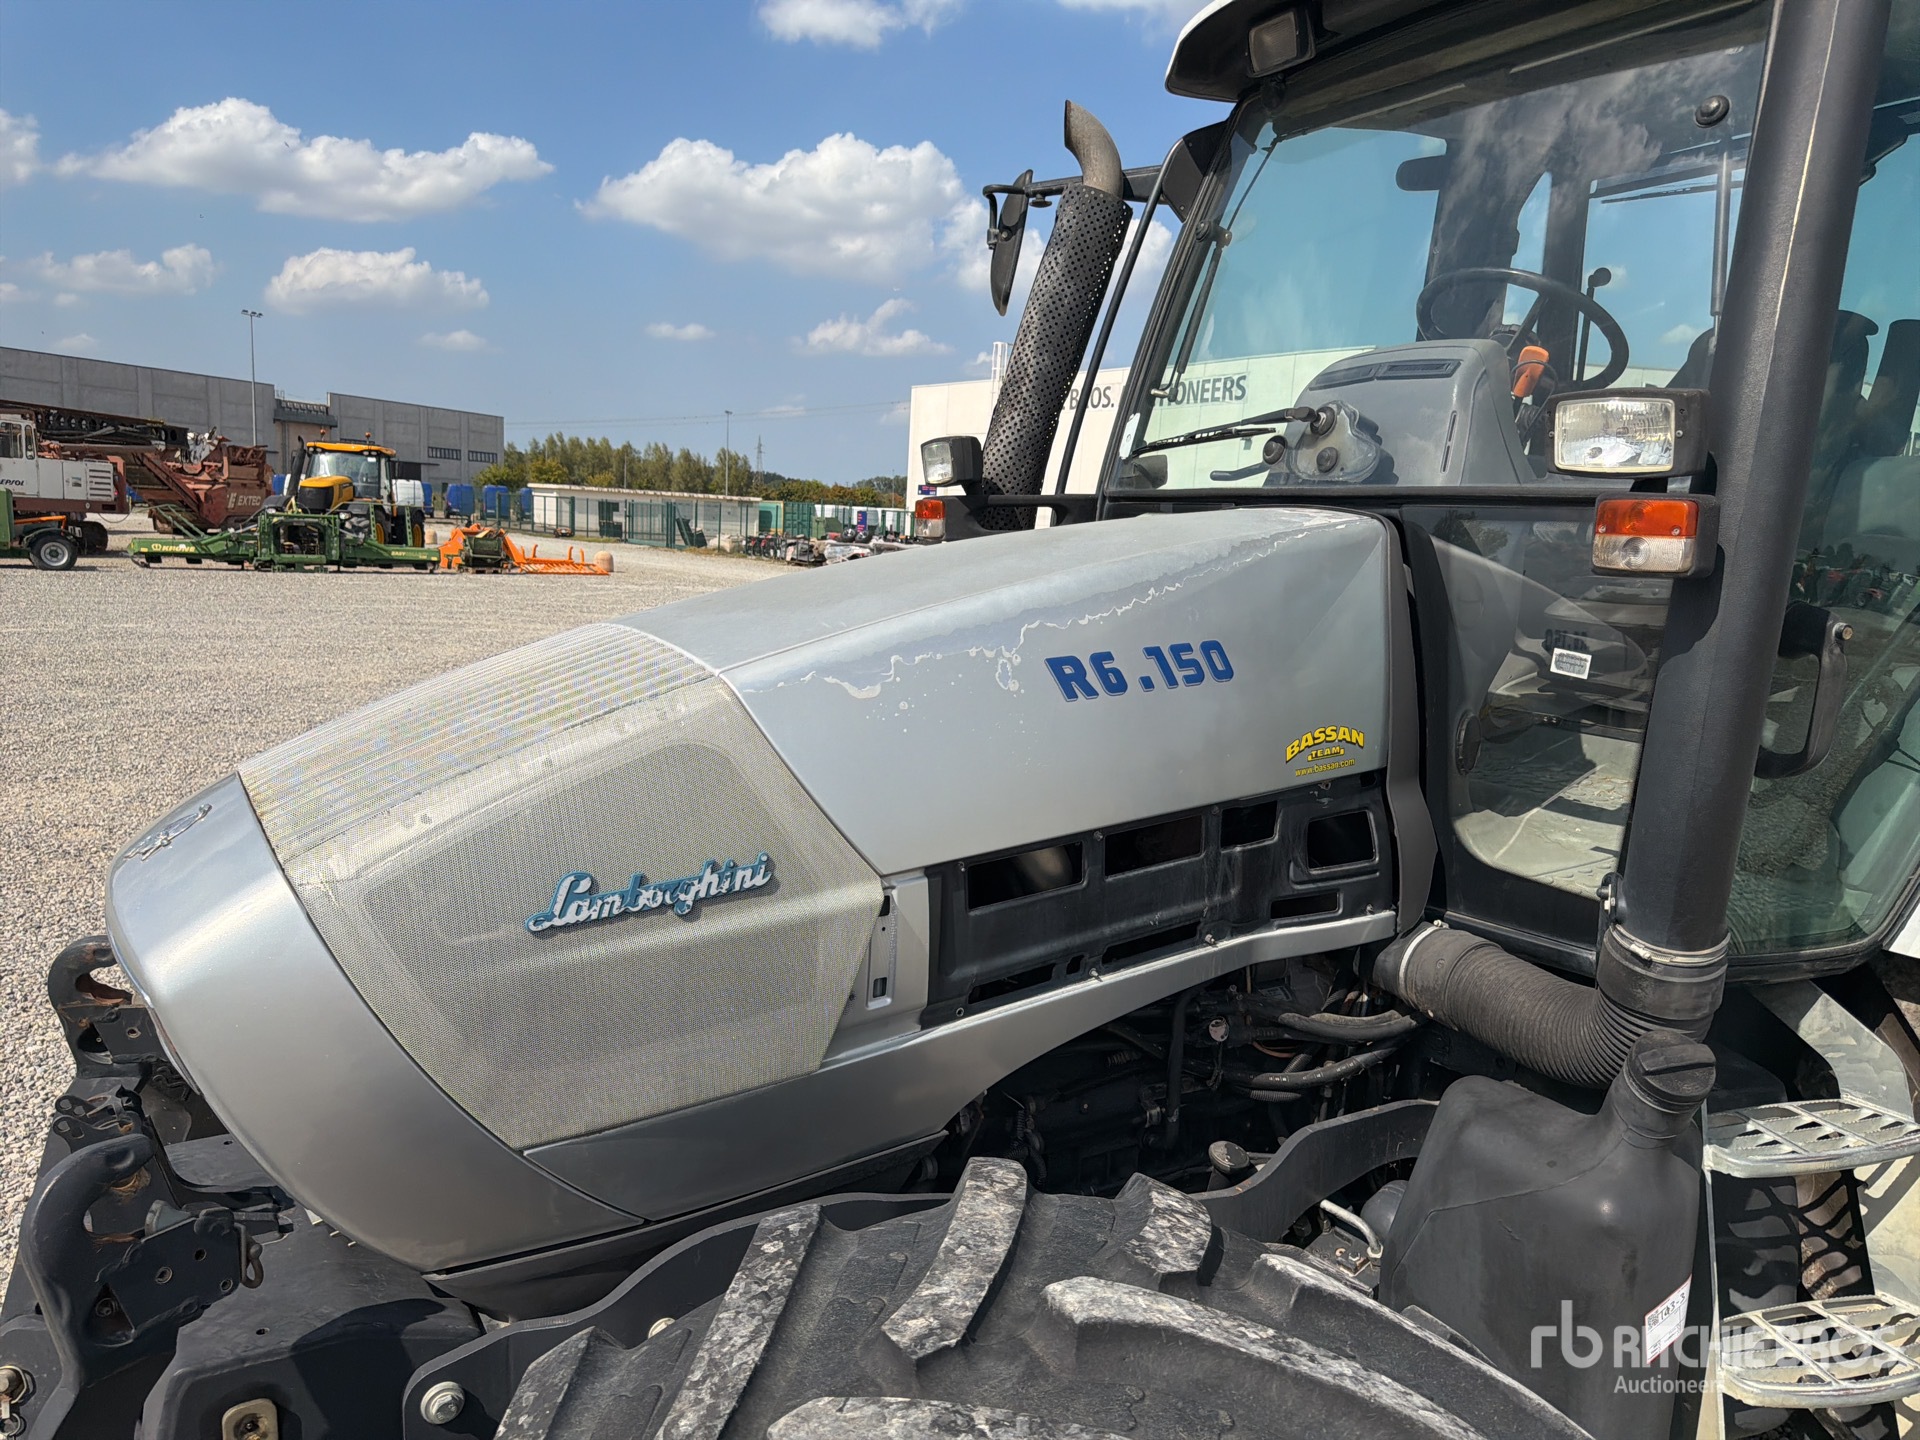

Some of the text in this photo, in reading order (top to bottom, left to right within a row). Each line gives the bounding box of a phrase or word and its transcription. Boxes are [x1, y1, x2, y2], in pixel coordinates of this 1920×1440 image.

[1070, 385, 1115, 411] BOS.
[1285, 725, 1365, 764] BASSAN
[1310, 746, 1341, 759] TEAM
[1295, 758, 1356, 777] www.bassan.com
[525, 851, 773, 932] Lamborghini
